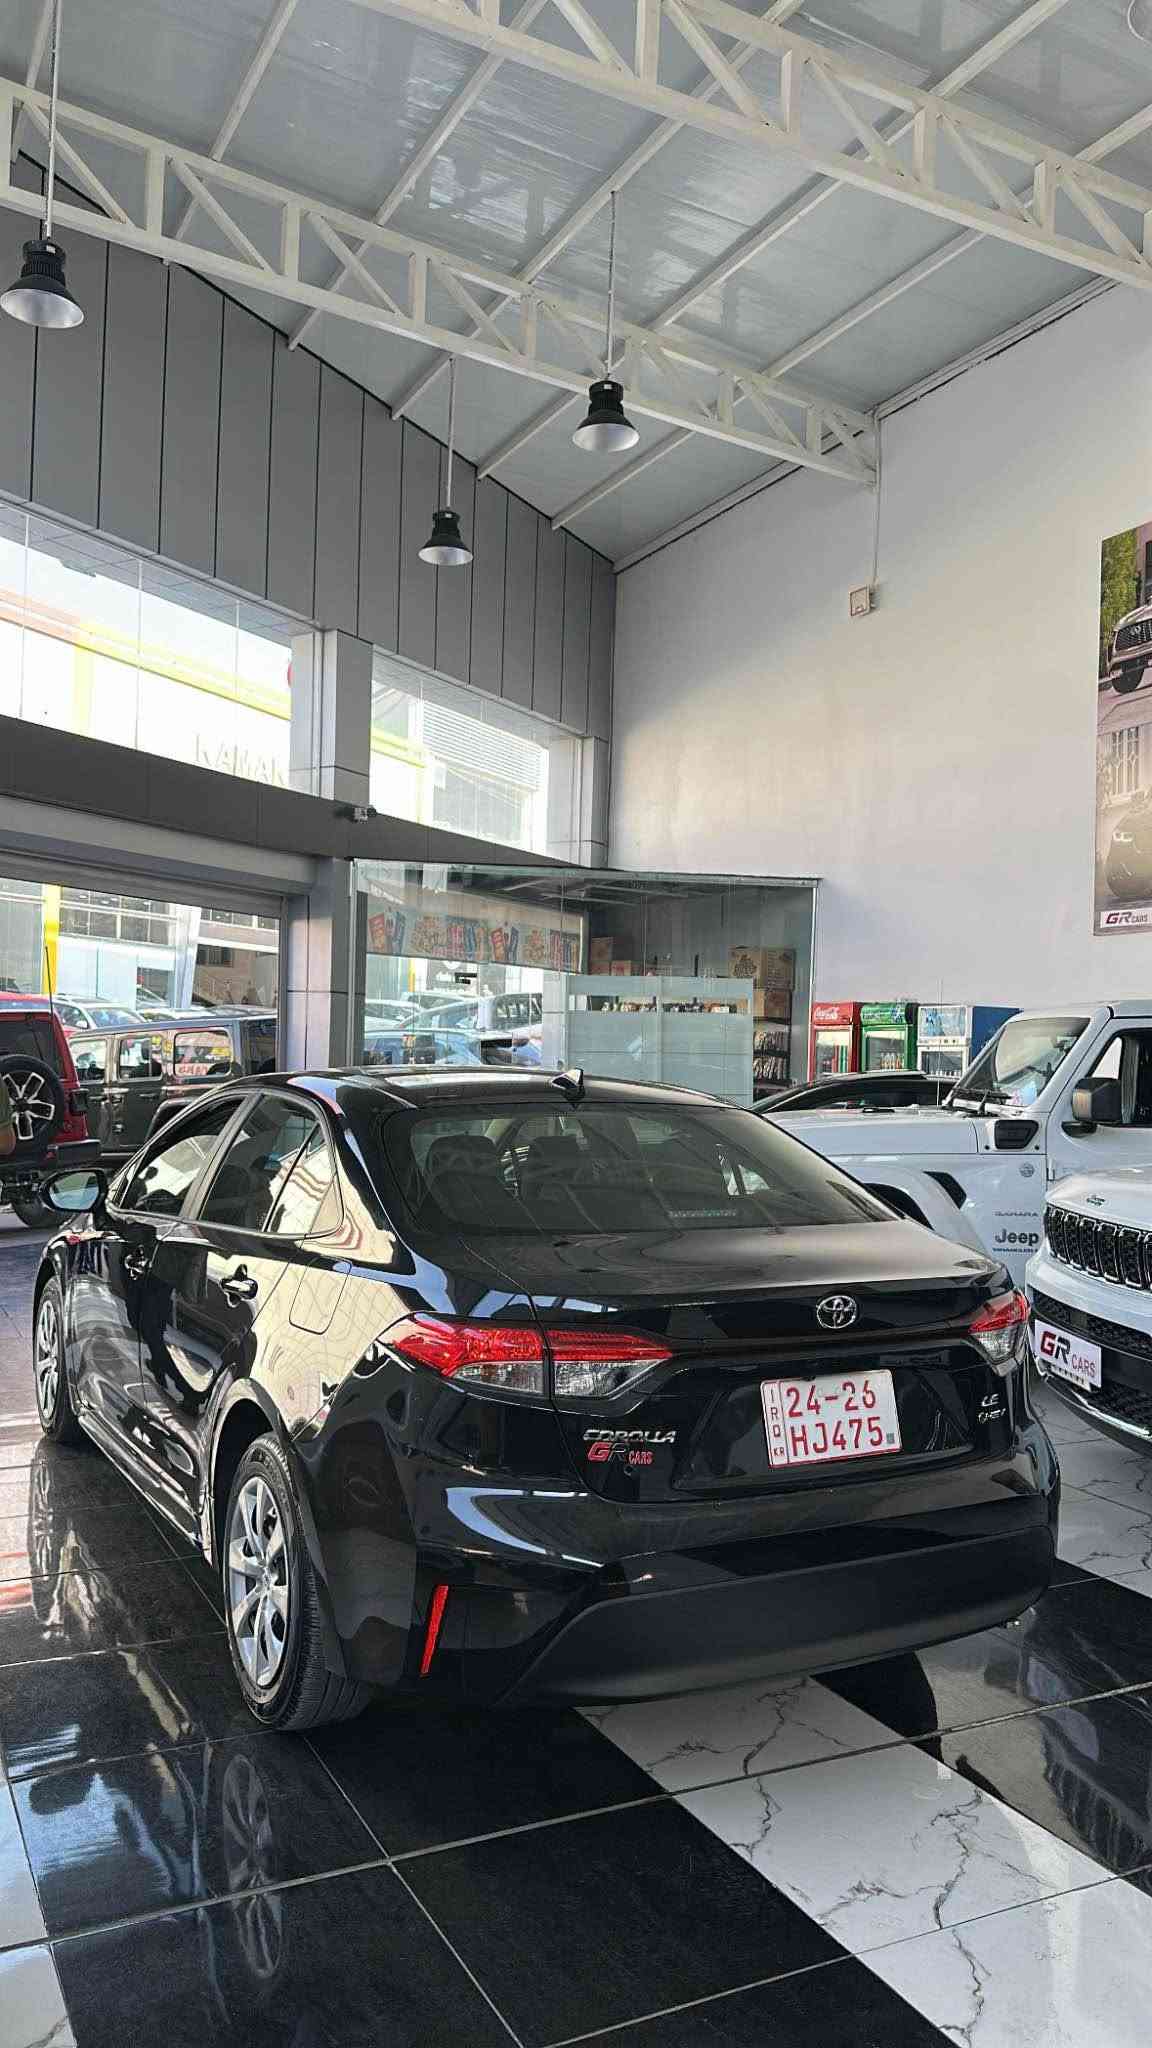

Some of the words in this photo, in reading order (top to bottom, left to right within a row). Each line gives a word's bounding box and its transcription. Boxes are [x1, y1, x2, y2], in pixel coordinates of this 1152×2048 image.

[1106, 912, 1131, 924] GR
[994, 1228, 1040, 1246] Jeep
[1041, 1330, 1071, 1364] GR
[1072, 1353, 1096, 1378] CARS
[786, 1380, 876, 1418] 24-26
[981, 1393, 999, 1407] LE
[583, 1429, 677, 1444] COROLLA
[790, 1416, 883, 1457] HJ475
[587, 1441, 626, 1462] GR
[628, 1449, 654, 1465] CARS
[773, 1446, 785, 1457] KR
